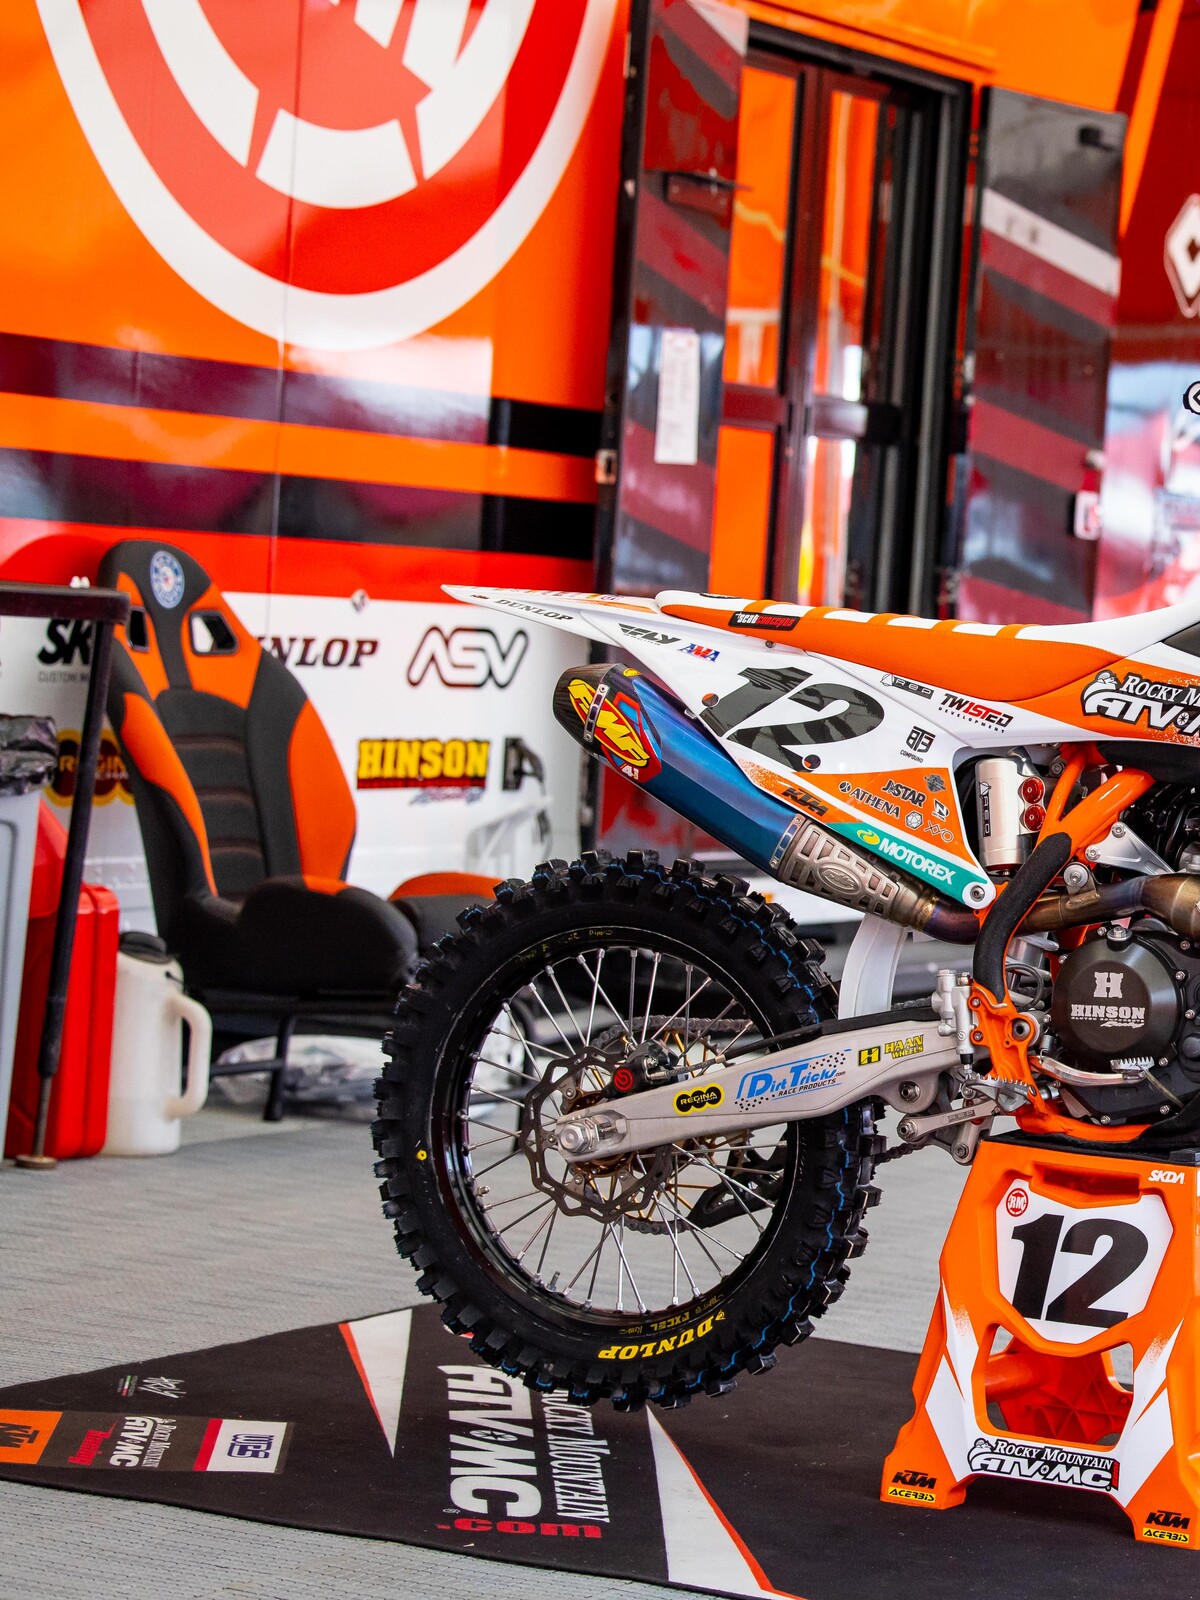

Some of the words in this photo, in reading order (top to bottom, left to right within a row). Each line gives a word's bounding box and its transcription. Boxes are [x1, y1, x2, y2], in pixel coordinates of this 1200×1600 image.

[494, 599, 573, 621] DUNLOP
[618, 623, 681, 644] FLY
[258, 637, 379, 667] NLOP
[407, 626, 529, 688] ASV
[679, 643, 721, 662] AMA
[1120, 675, 1183, 701] ROCKY
[699, 666, 885, 773] 12
[938, 707, 1005, 733] DEVELOPMENT
[940, 693, 1014, 727] TWISTED
[357, 738, 491, 780] HINSON
[900, 749, 924, 763] COMPOUND
[782, 787, 829, 817] KTM
[849, 786, 901, 819] ATHENA
[878, 836, 957, 886] MOTOREX
[1093, 971, 1124, 999] H
[1070, 1003, 1146, 1020] HINSON
[884, 1034, 925, 1054] HAAN
[891, 1046, 924, 1060] WHEELS
[748, 1072, 788, 1099] Dirt
[789, 1063, 836, 1087] Tricks
[778, 1087, 798, 1098] RACE
[798, 1078, 837, 1095] PRODUCTS
[680, 1090, 718, 1107] REGINA
[1148, 1169, 1184, 1185] SKDA
[1011, 1213, 1149, 1329] 12
[650, 1311, 690, 1332] EXCEL
[598, 1315, 715, 1360] DUNLOP
[995, 1440, 1042, 1460] ROCKY
[1041, 1448, 1112, 1471] MOUNTAIN
[547, 1439, 611, 1523] MOUNTAIN
[892, 1469, 937, 1490] KTM
[889, 1488, 935, 1502] ACERBIS
[1145, 1509, 1191, 1529] KTM
[1143, 1528, 1190, 1543] ACERBIS
